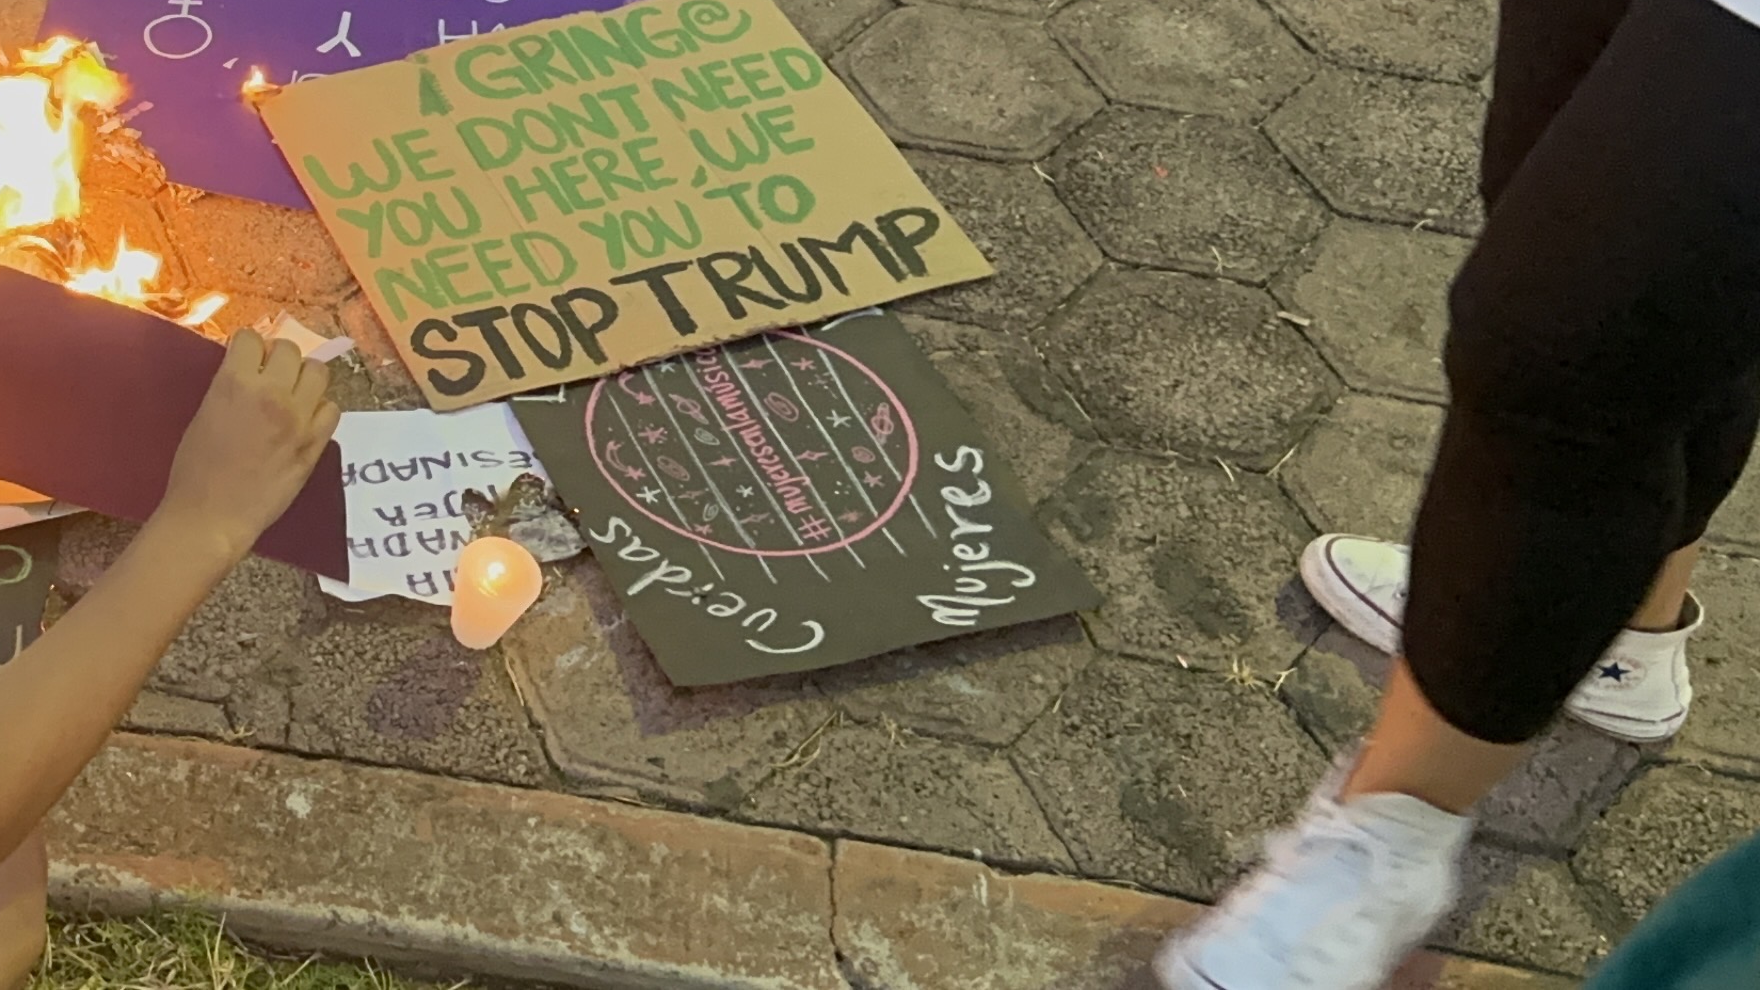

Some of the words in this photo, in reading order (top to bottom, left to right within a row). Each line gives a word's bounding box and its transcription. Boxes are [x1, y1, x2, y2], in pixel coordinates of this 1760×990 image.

[303, 127, 454, 201] WE
[457, 82, 649, 171] DONT
[652, 45, 825, 113] NEED
[336, 185, 482, 258] YOU
[690, 104, 815, 174] WE
[374, 230, 579, 321] NEED
[579, 200, 705, 271] YOU
[703, 172, 815, 230] TO
[410, 287, 619, 397] STOP
[610, 206, 940, 335] TRUMP
[339, 448, 538, 486] ESINADA
[916, 444, 1037, 627] Mujeres
